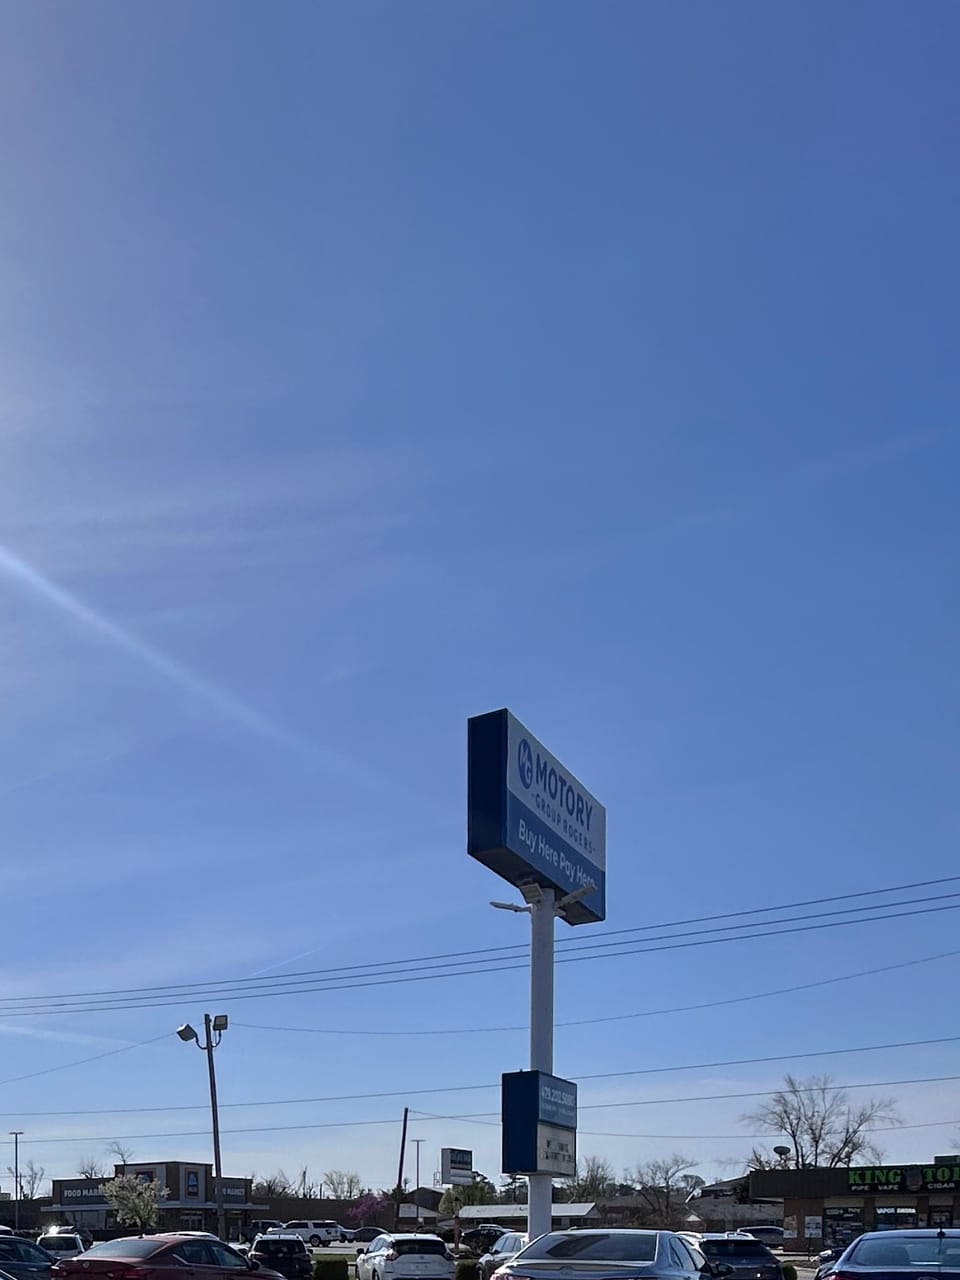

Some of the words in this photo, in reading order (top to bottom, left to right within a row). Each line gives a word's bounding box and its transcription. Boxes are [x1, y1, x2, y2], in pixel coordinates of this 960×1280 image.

[535, 752, 593, 832] MOTORY
[518, 818, 538, 854] Buy
[538, 833, 559, 867] Here
[559, 851, 576, 883] Pay
[64, 1189, 82, 1198] FOOD
[847, 1168, 901, 1184] KING
